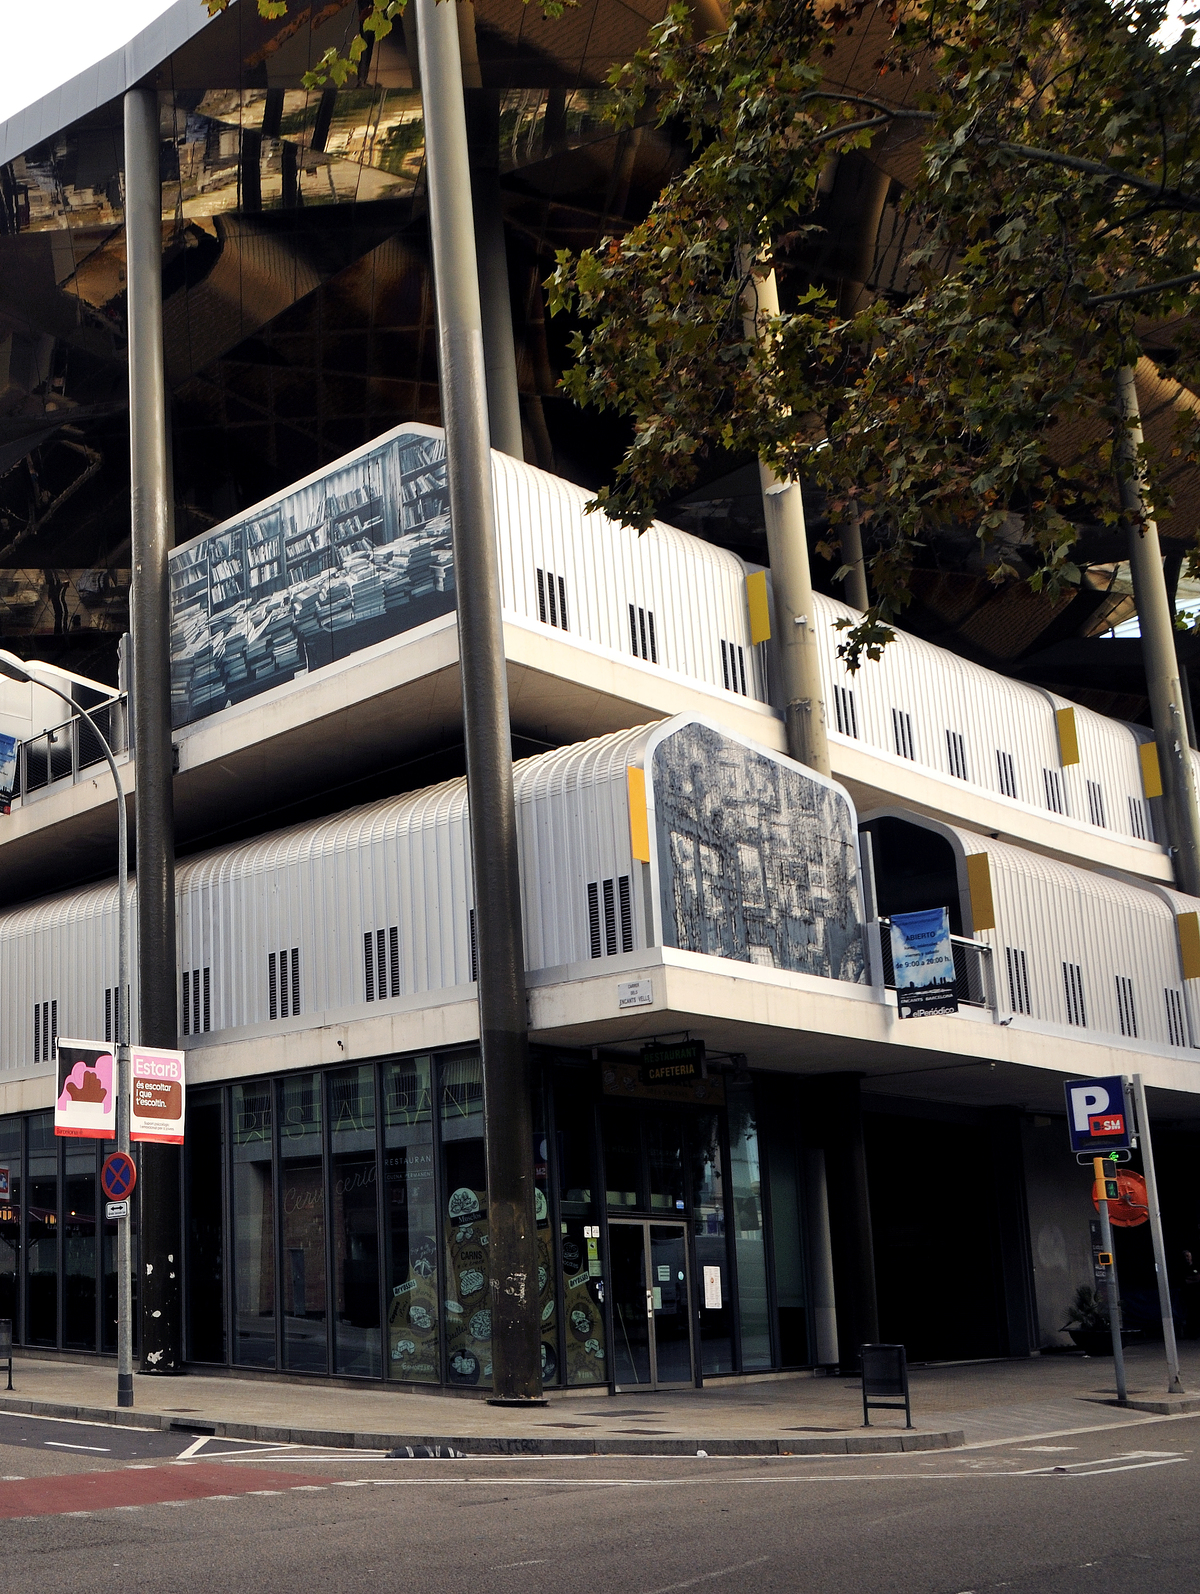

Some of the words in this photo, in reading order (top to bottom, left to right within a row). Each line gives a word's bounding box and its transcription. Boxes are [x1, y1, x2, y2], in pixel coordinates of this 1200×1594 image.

[905, 931, 936, 941] ABIERTO
[904, 960, 920, 968] 9:00
[926, 956, 943, 965] 20:00
[620, 997, 636, 1005] ENCANTS
[912, 1006, 955, 1018] elPeriódico
[644, 1047, 696, 1063] RESTAURANT
[136, 1059, 178, 1077] EstarB
[649, 1064, 695, 1079] CAFETERIA
[136, 1080, 144, 1089] és
[145, 1083, 171, 1092] escoltar
[237, 1081, 483, 1148] RESTAURAN
[1071, 1086, 1110, 1131] P
[385, 1156, 433, 1166] RESTAURAN
[461, 1251, 483, 1261] CARNS
